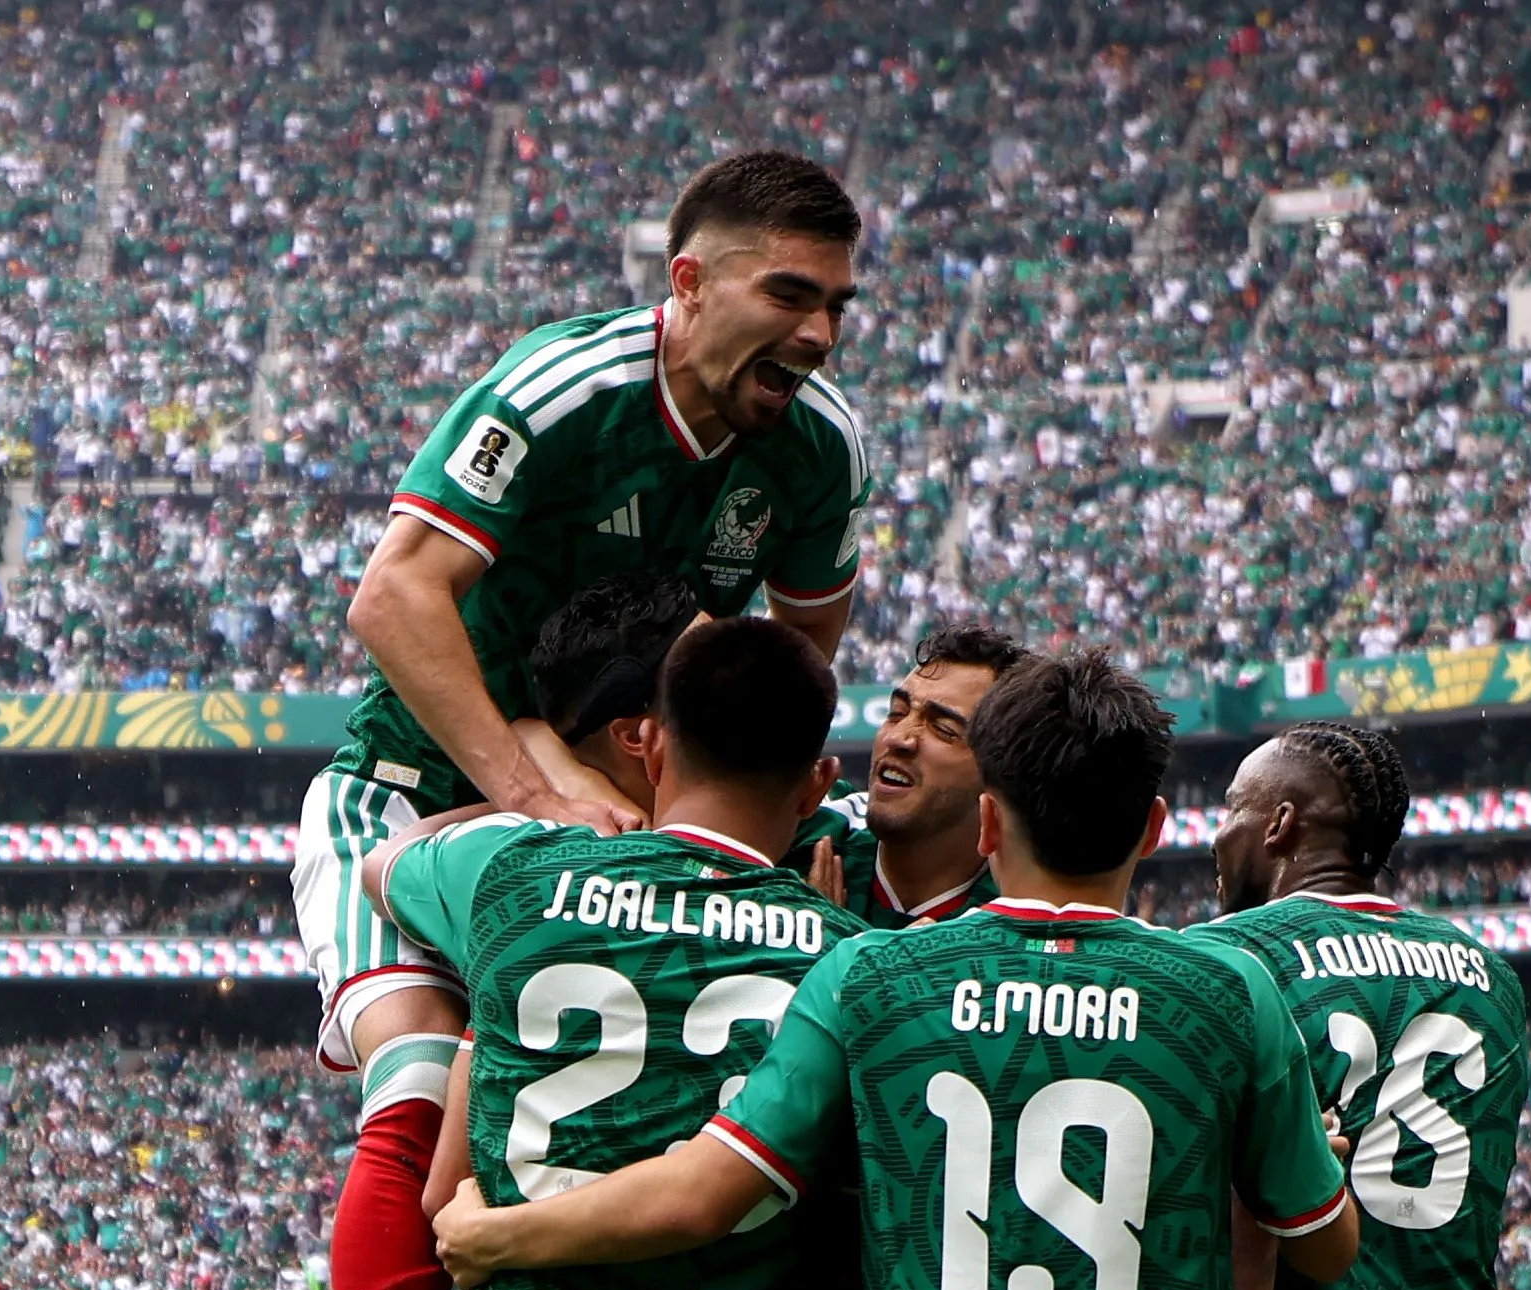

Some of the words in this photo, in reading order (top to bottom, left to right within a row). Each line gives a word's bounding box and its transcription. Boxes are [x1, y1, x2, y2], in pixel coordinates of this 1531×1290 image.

[459, 473, 488, 493] 2026
[543, 871, 823, 955] J.GALLARDO
[1292, 931, 1490, 992] J.QUIÑONES
[951, 979, 1140, 1042] G.MORA
